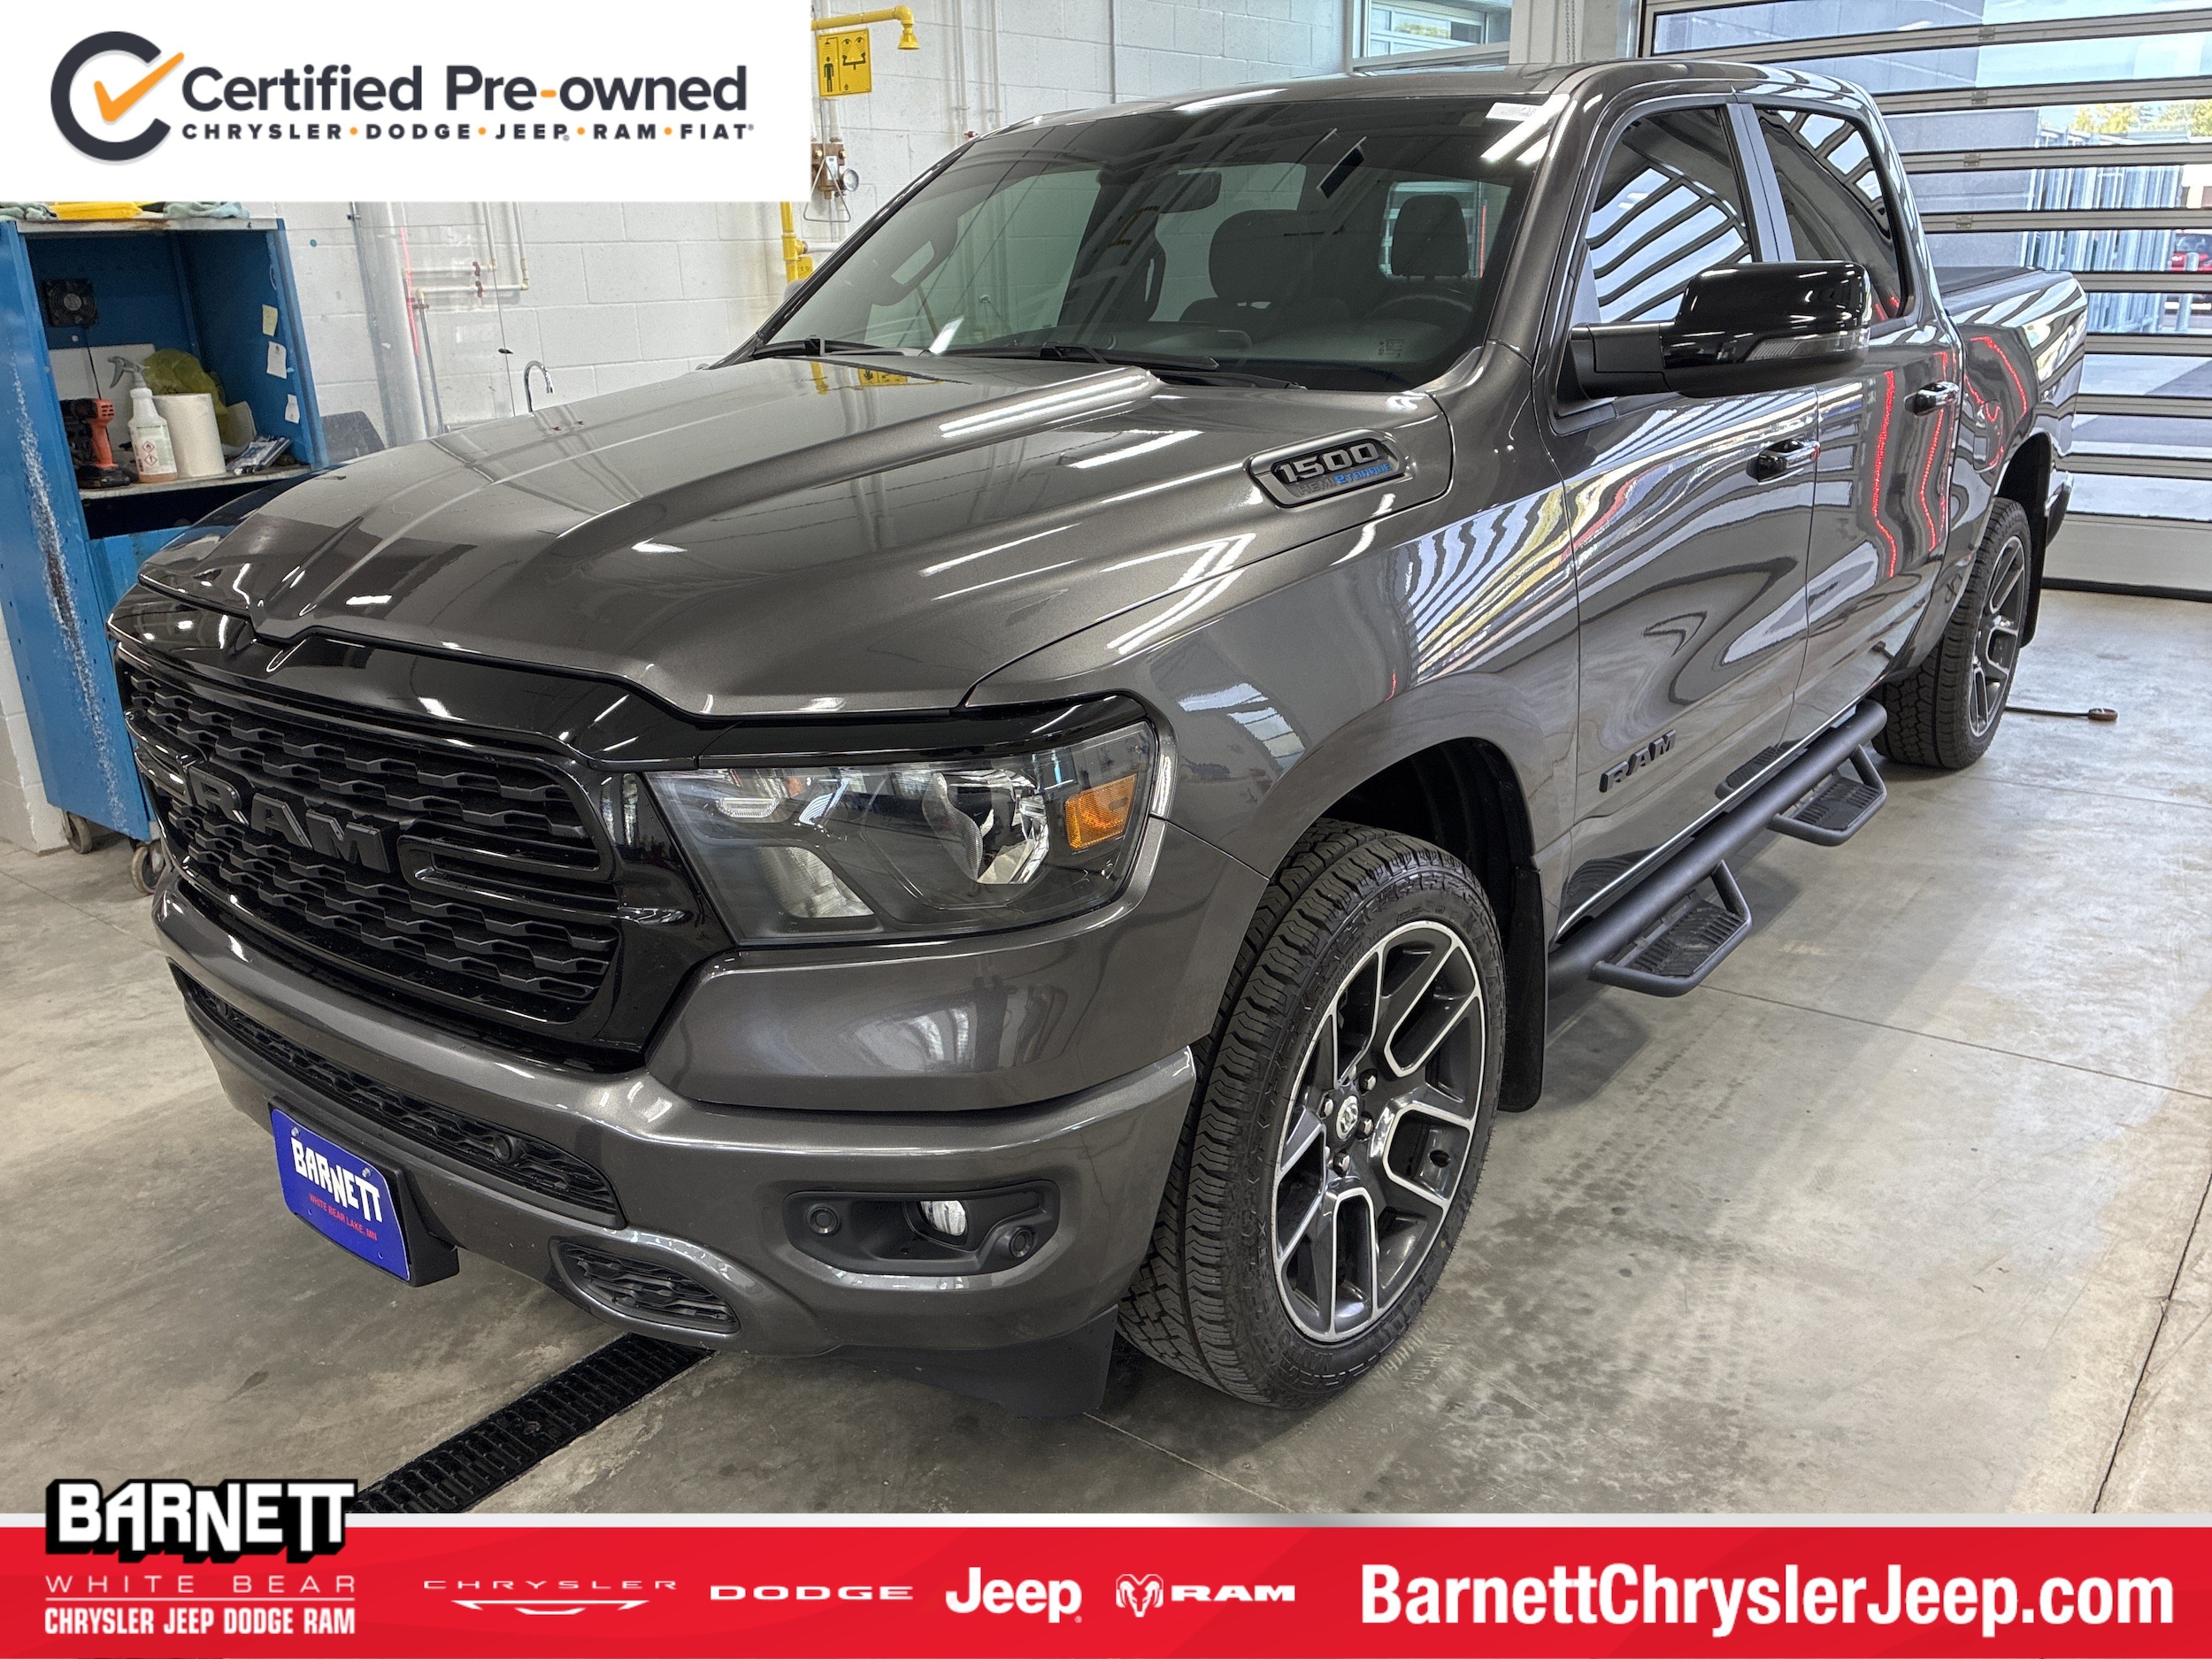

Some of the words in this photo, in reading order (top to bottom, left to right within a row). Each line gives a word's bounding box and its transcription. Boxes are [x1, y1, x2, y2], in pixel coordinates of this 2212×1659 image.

[1274, 442, 1379, 483] 1500
[1297, 476, 1338, 495] HEMI
[1599, 728, 1677, 793] RAM
[188, 759, 397, 874] RAM
[291, 1137, 383, 1223] BARNETT
[309, 1192, 328, 1212] WHITE
[328, 1205, 346, 1223] BEAR
[365, 1227, 378, 1241] MN
